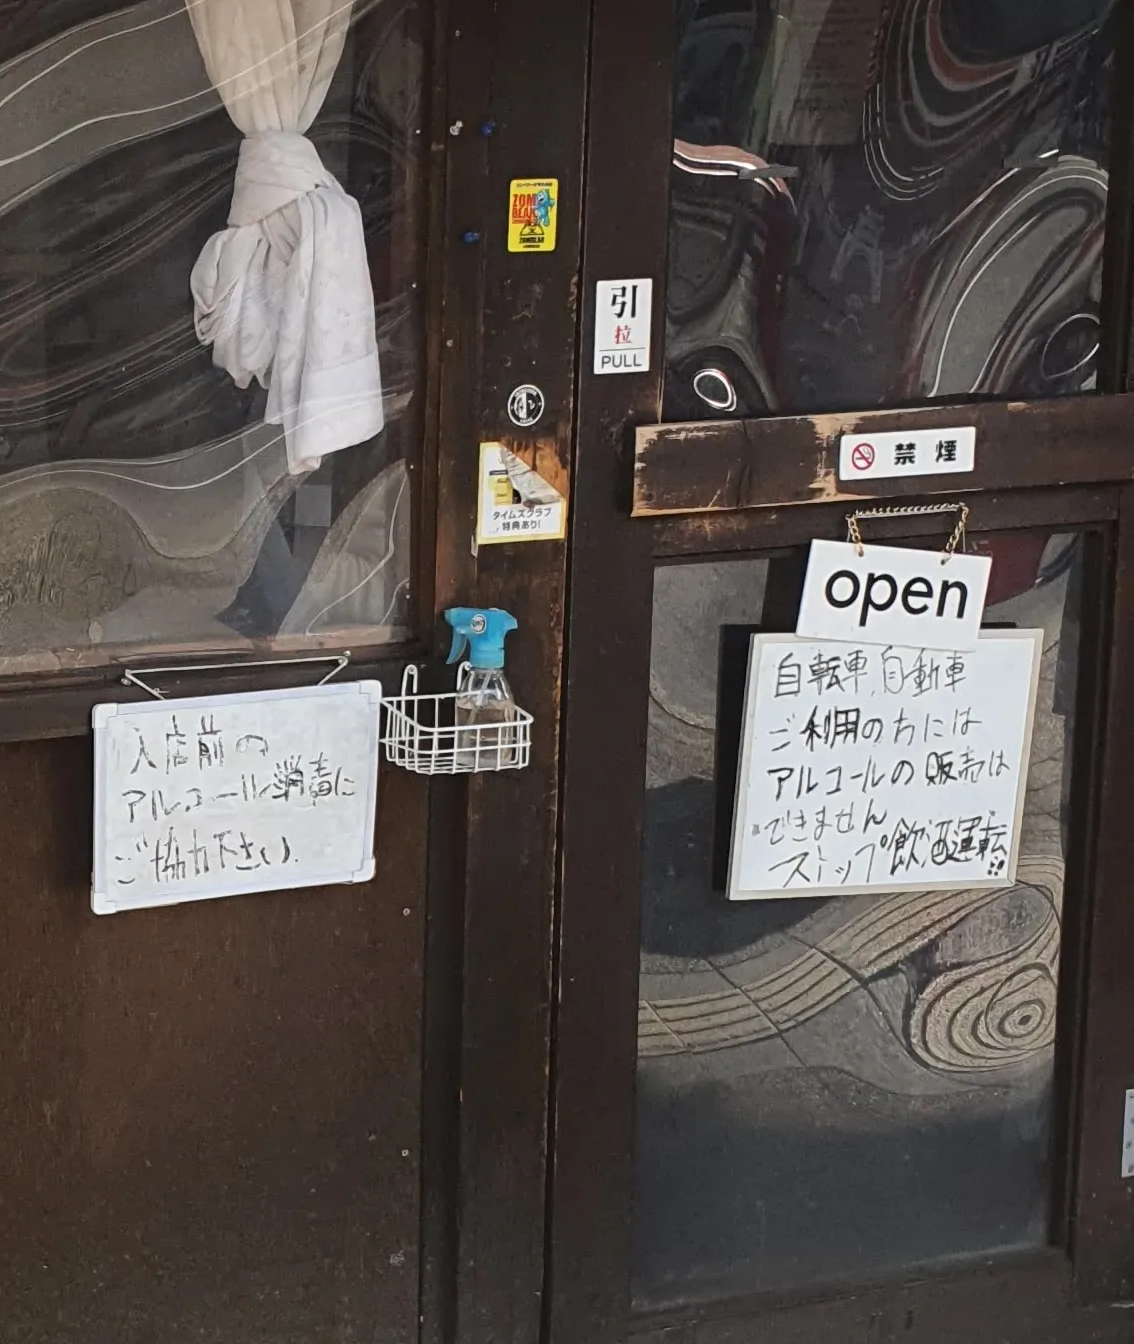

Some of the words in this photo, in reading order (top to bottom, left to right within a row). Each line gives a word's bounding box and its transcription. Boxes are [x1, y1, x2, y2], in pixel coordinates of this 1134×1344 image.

[610, 284, 638, 319] 引
[613, 324, 633, 345] 拉
[600, 355, 643, 370] PULL
[893, 439, 958, 467] 禁煙
[492, 507, 552, 521] タイムズクラブ
[824, 568, 970, 628] open
[130, 714, 270, 775] 入店前の
[767, 750, 1011, 802] アルコールの販売は
